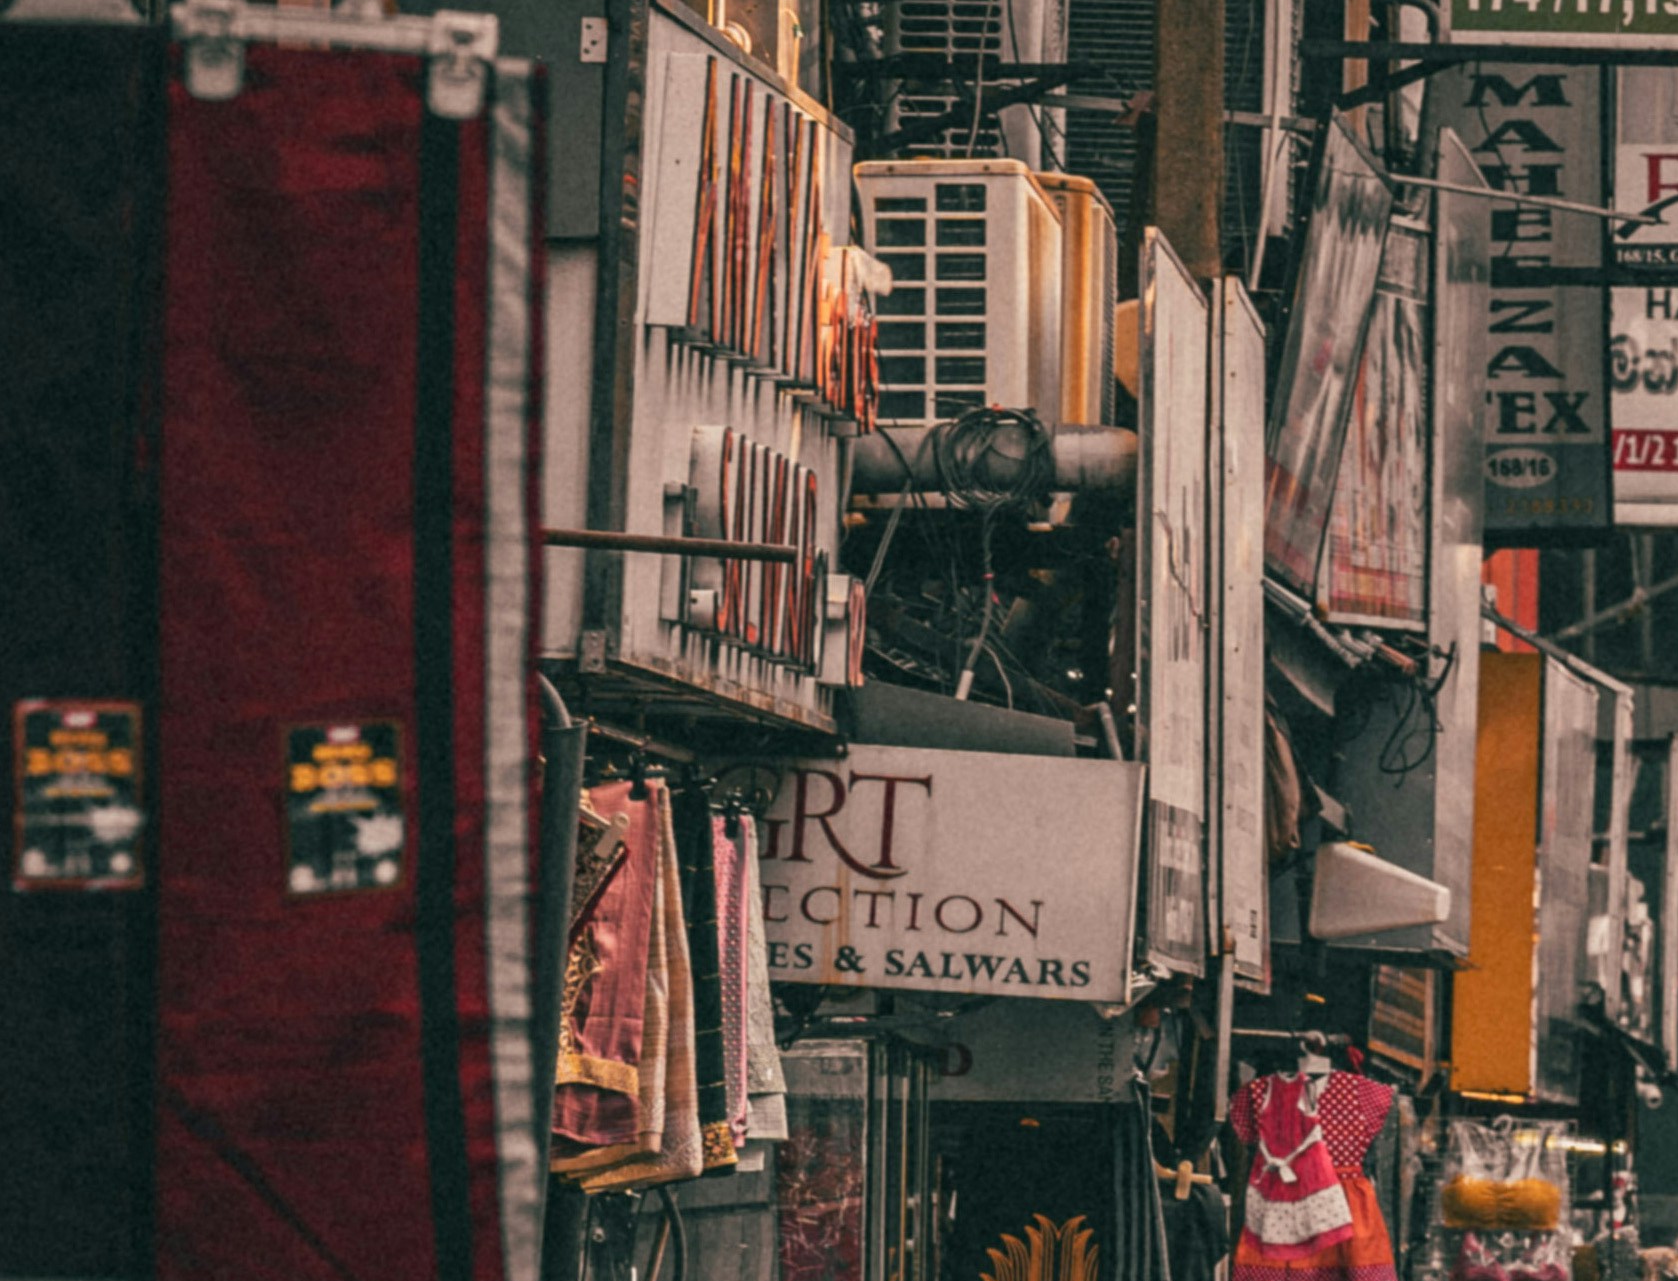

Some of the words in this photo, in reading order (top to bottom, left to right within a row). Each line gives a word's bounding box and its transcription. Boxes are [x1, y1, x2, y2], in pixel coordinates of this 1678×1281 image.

[1486, 391, 1591, 434] EX
[834, 946, 866, 974] &
[885, 950, 1092, 988] SALWARS
